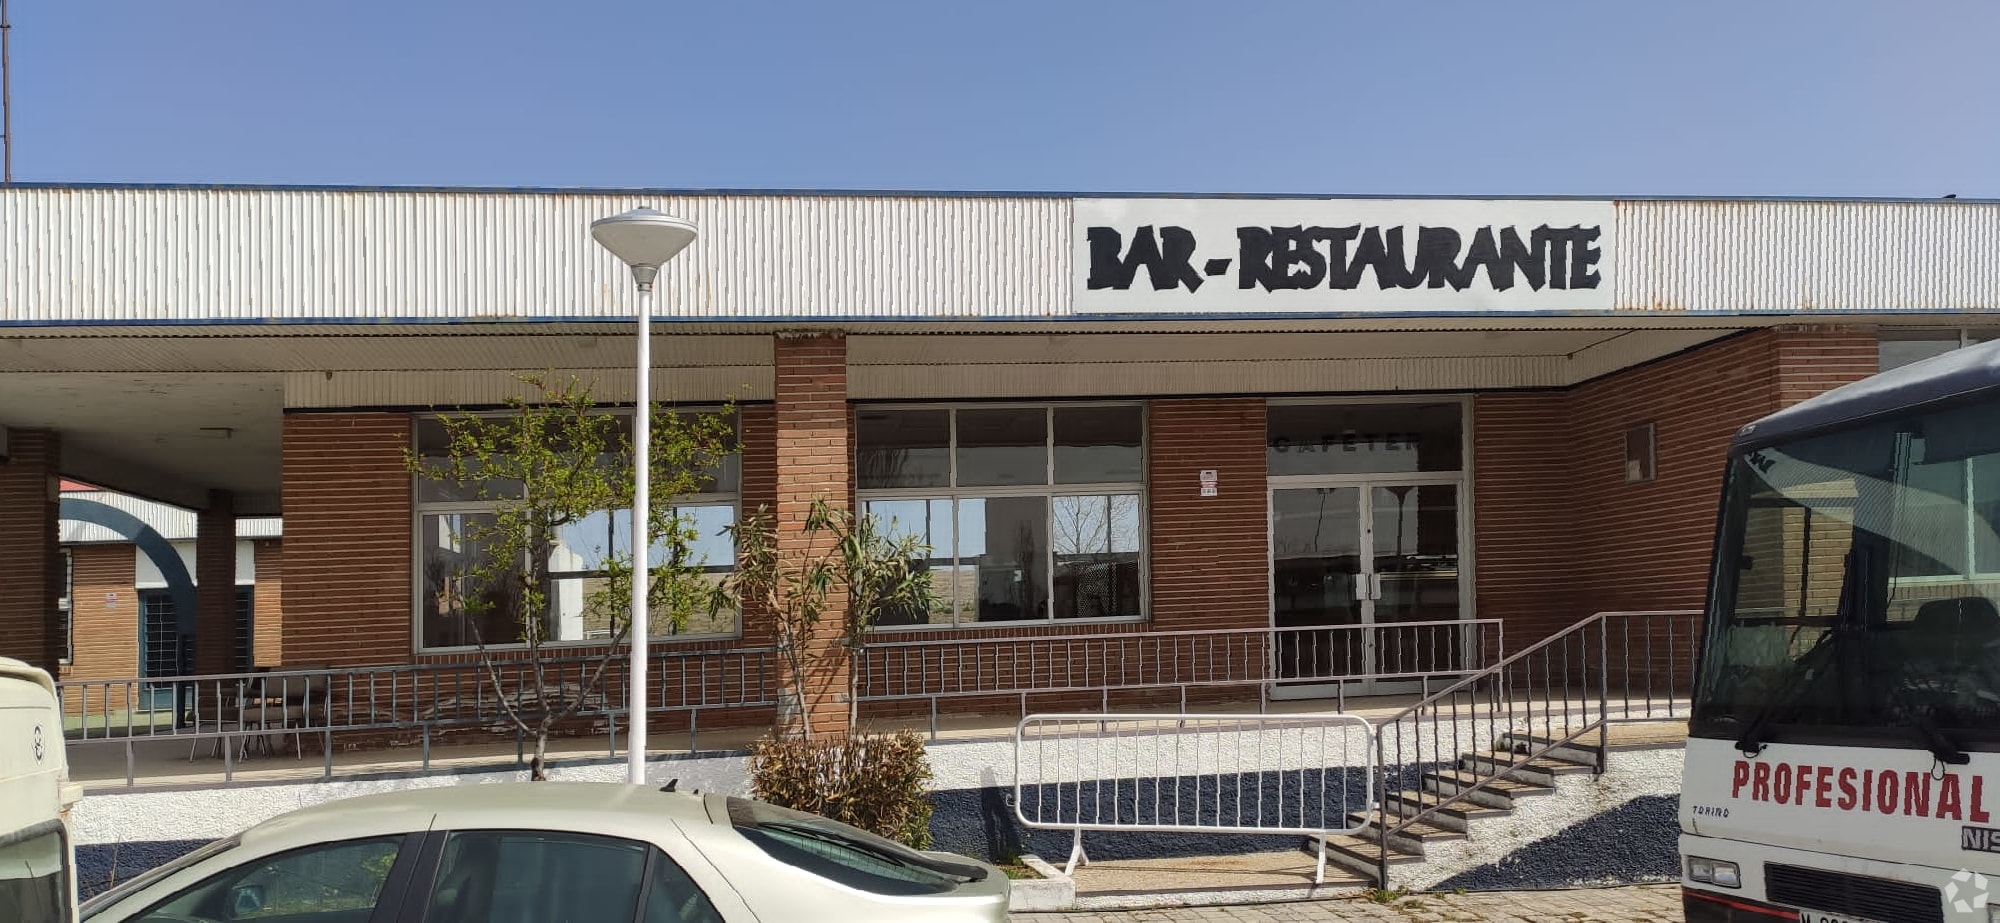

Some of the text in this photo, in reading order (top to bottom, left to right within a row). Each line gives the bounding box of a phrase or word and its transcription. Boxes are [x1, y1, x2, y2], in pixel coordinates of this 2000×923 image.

[1086, 224, 1204, 294] BAR
[1237, 224, 1602, 293] RESTAURANTE
[1732, 760, 1991, 823] PROFESIONAL
